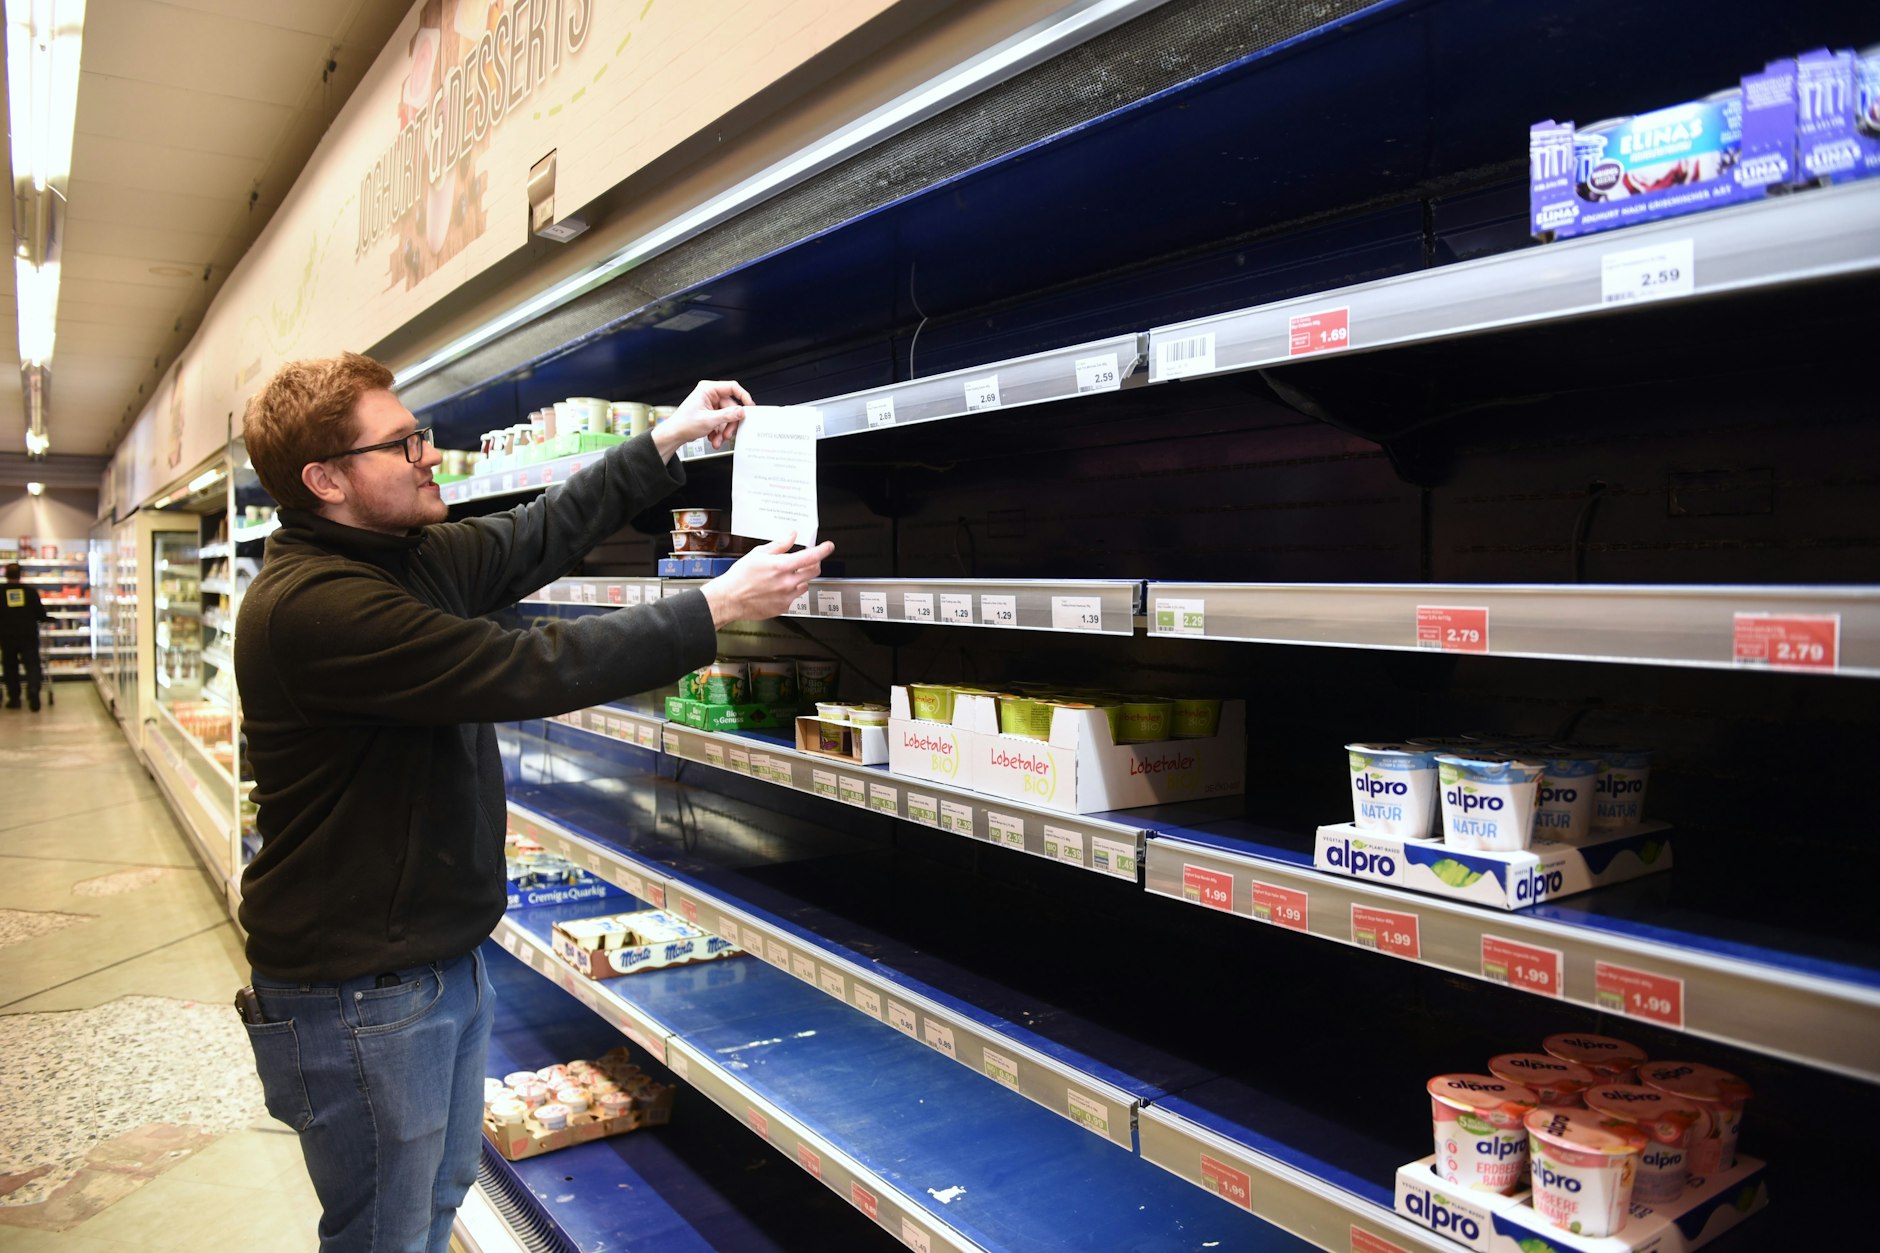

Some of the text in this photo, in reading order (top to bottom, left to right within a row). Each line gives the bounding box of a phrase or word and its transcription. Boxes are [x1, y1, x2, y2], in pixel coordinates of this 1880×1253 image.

[1620, 119, 1703, 154] ELINAS
[1805, 143, 1862, 171] ELINAS
[356, 102, 429, 260] JOGHURT
[428, 85, 444, 184] &
[1734, 158, 1788, 184] ELINAS
[1536, 204, 1580, 225] ELINAS
[1641, 268, 1681, 288] 2.59
[1320, 328, 1347, 343] 1.69
[1095, 372, 1114, 384] 2.59
[980, 393, 996, 404] 2.69
[879, 411, 892, 421] 2.69
[872, 606, 884, 614] 1.29
[917, 608, 931, 616] 1.29
[954, 609, 969, 618] 1.29
[996, 611, 1012, 620] 1.29
[1081, 614, 1099, 624] 1.39
[1184, 615, 1203, 627] 2.29
[1447, 628, 1480, 643] 2.79
[720, 716, 744, 725] Genuss
[726, 710, 738, 718] Bio
[904, 731, 953, 755] Lobetaler
[991, 748, 1049, 775] Lobetaler
[1131, 752, 1195, 776] Lobetaler
[1356, 773, 1408, 798] alpro
[1596, 774, 1643, 798] alpro
[1447, 786, 1504, 813] alpro
[1538, 787, 1577, 806] pro
[920, 809, 934, 819] 1.39
[1361, 803, 1403, 822] NATUR
[957, 819, 971, 830] 2.39
[1535, 812, 1571, 829] ATUR
[1453, 818, 1498, 839] NATUR
[1007, 832, 1023, 843] 2.39
[1065, 847, 1082, 859] 2.39
[1327, 839, 1395, 877] alpro
[1117, 857, 1134, 870] 1.49
[1517, 866, 1563, 904] alpro
[1205, 888, 1227, 902] 1.99
[1276, 906, 1301, 921] 1.99
[1382, 931, 1411, 946] 1.99
[665, 941, 694, 960] Monte
[1515, 965, 1549, 985] 1.99
[1633, 993, 1671, 1014] 1.99
[901, 1018, 913, 1031] 0.89
[938, 1037, 951, 1050] 0.89
[1563, 1038, 1619, 1050] alpro
[1510, 1059, 1568, 1071] alpro
[1000, 1070, 1014, 1082] 0.99
[1448, 1080, 1506, 1093] alpro
[1602, 1090, 1661, 1102] alpro
[1086, 1113, 1104, 1128] 0.99
[1476, 1136, 1526, 1160] alpro
[1643, 1155, 1682, 1169] alpro
[1222, 1180, 1245, 1199] 1.99
[1405, 1190, 1479, 1240] alpro
